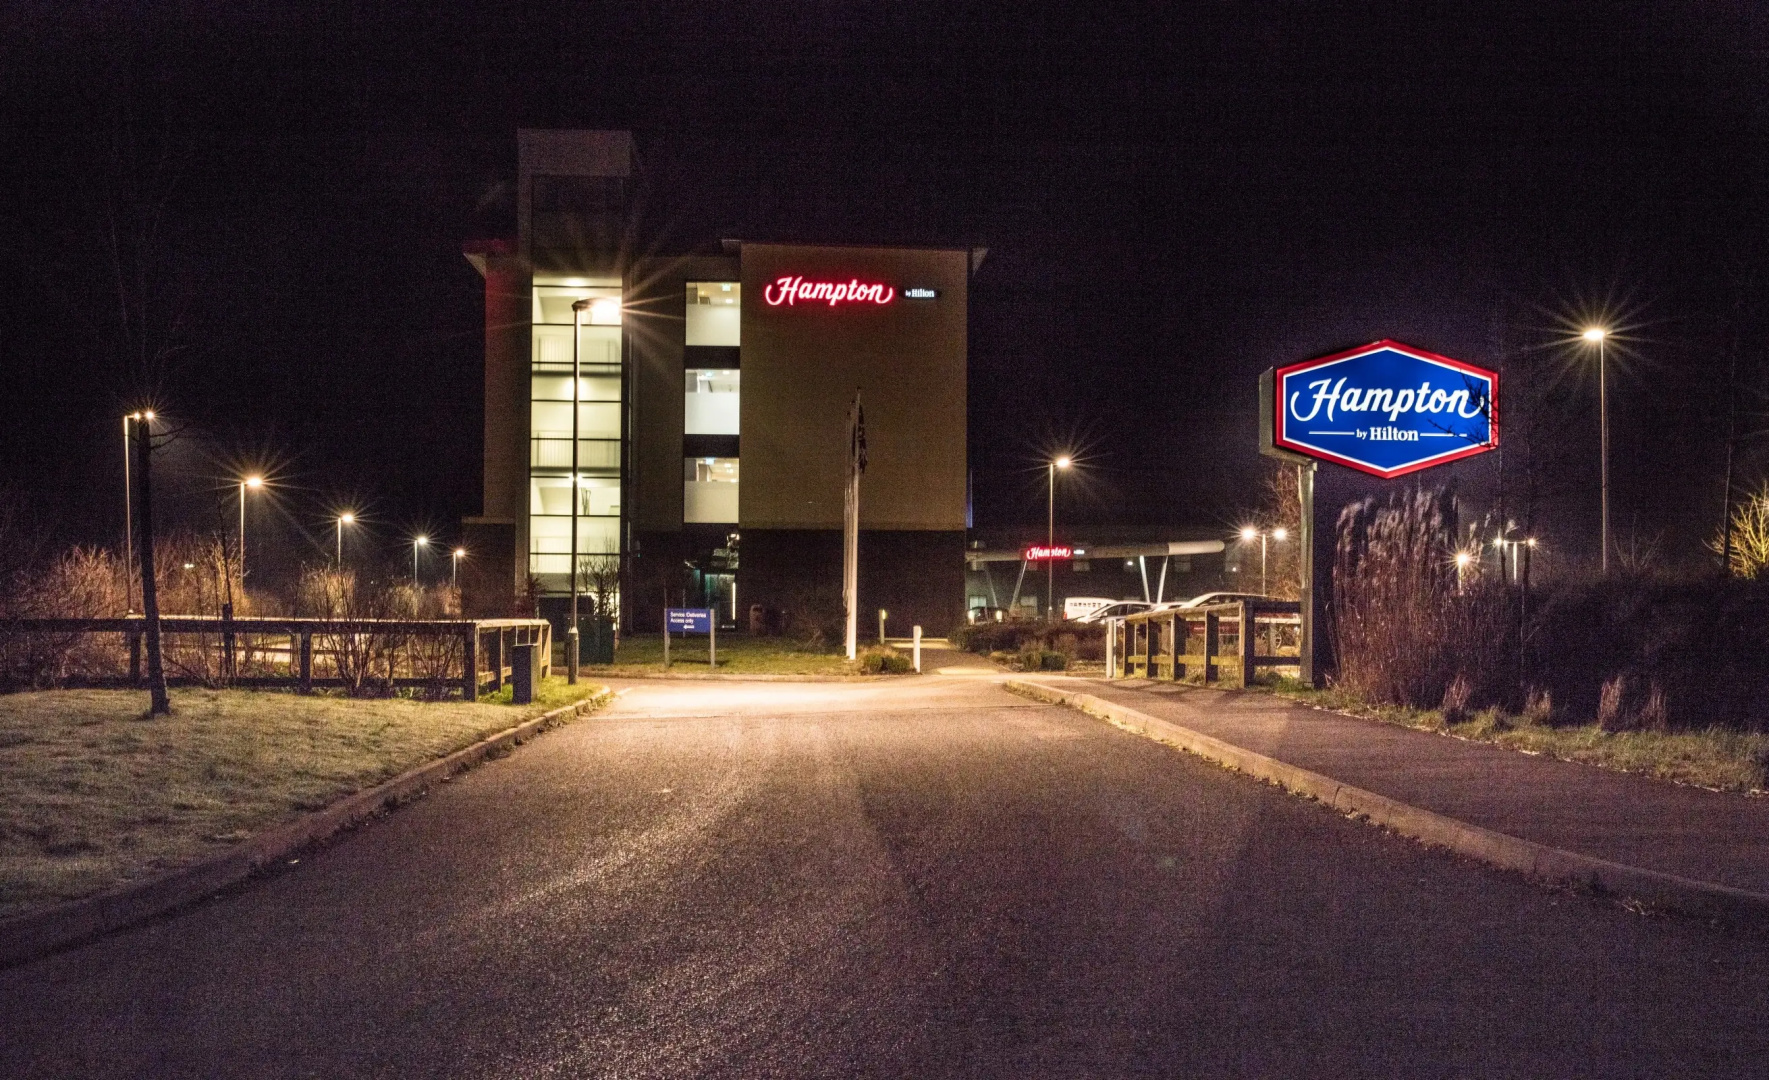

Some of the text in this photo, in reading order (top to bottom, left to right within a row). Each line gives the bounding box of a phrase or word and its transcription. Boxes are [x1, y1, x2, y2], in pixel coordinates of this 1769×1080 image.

[765, 275, 893, 306] Hampton
[911, 288, 935, 298] Hilton
[1290, 376, 1484, 422] Hampton
[1356, 426, 1419, 441] by Hilton
